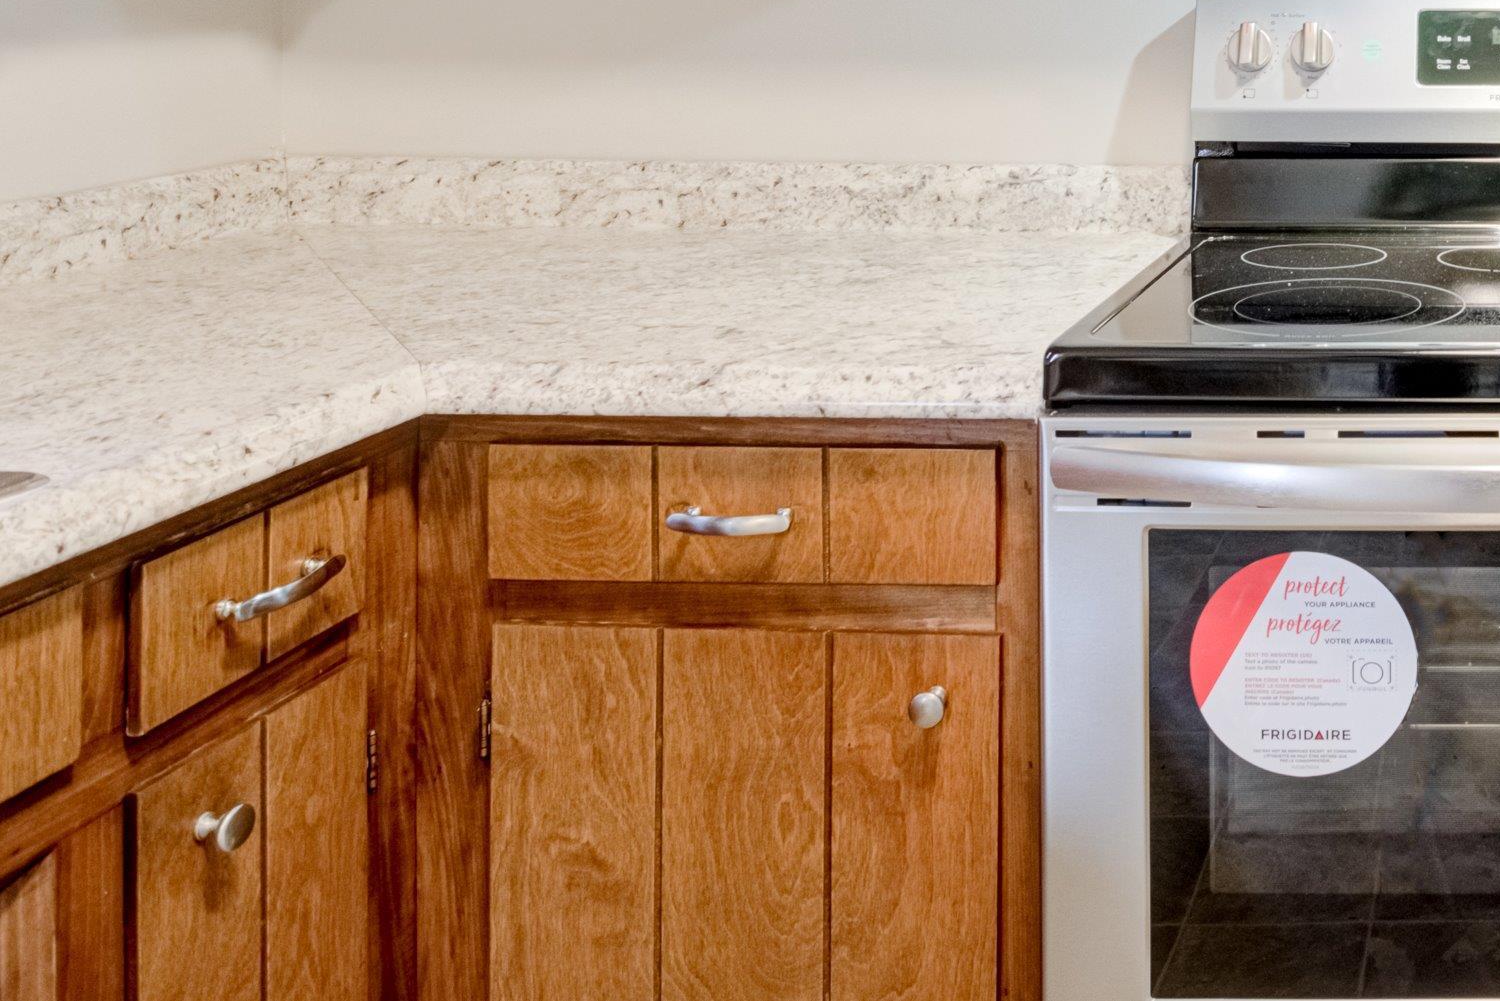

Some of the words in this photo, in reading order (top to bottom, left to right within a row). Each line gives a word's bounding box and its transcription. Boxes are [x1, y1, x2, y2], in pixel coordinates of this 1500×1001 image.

[1284, 576, 1349, 600] protect
[1266, 612, 1342, 645] protégez
[1261, 729, 1352, 741] FRIGIDAIRE
